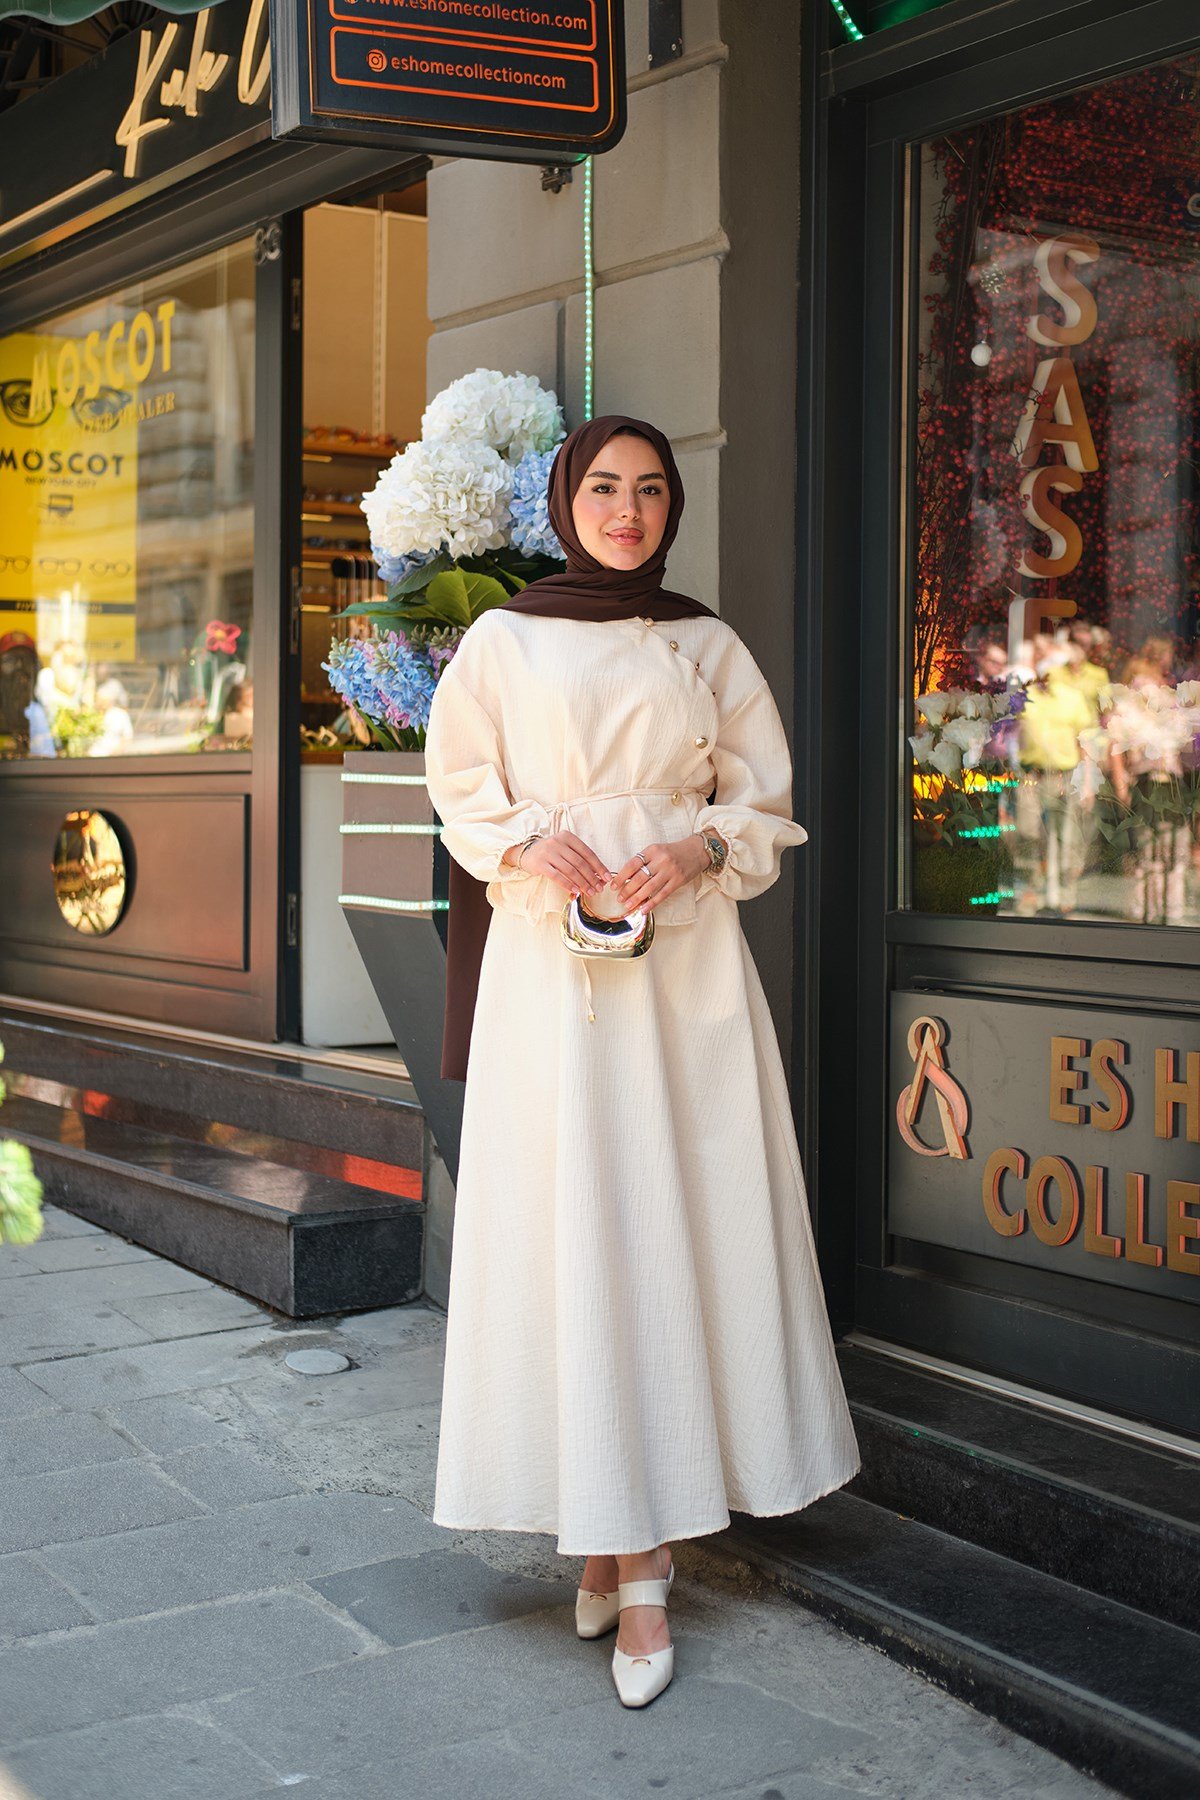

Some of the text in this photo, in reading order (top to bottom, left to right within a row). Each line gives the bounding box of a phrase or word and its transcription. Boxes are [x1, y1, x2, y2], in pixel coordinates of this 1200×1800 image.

[365, 0, 588, 30] w.eshomecollection.com
[391, 55, 567, 90] eshomecollectioncom
[29, 300, 176, 418] MOSCOT
[0, 448, 124, 476] MOSCOT
[1050, 1036, 1132, 1132] ES
[982, 1147, 1200, 1276] COLLE
